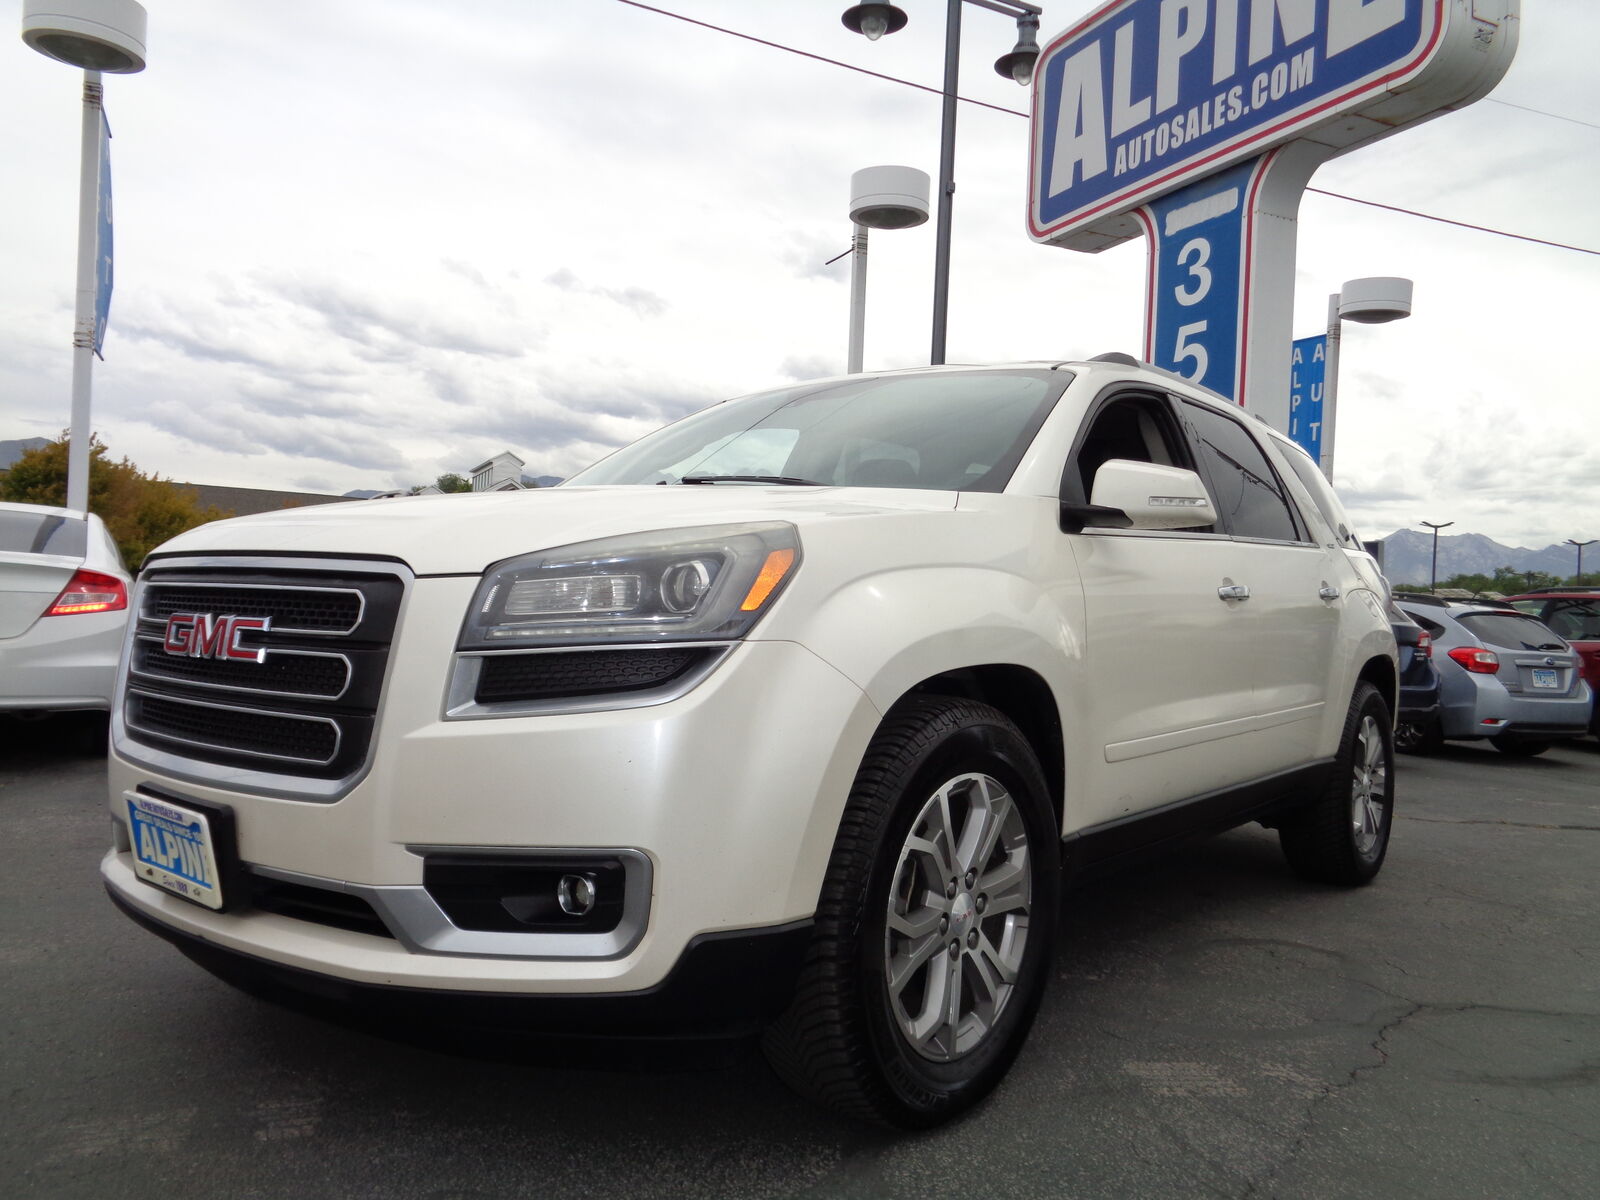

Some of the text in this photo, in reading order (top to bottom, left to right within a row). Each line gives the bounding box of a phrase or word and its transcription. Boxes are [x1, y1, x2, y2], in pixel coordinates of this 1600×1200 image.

[1114, 48, 1315, 177] AUTOSALES.COM
[1292, 346, 1303, 443] ALPI
[164, 612, 272, 664] GMC
